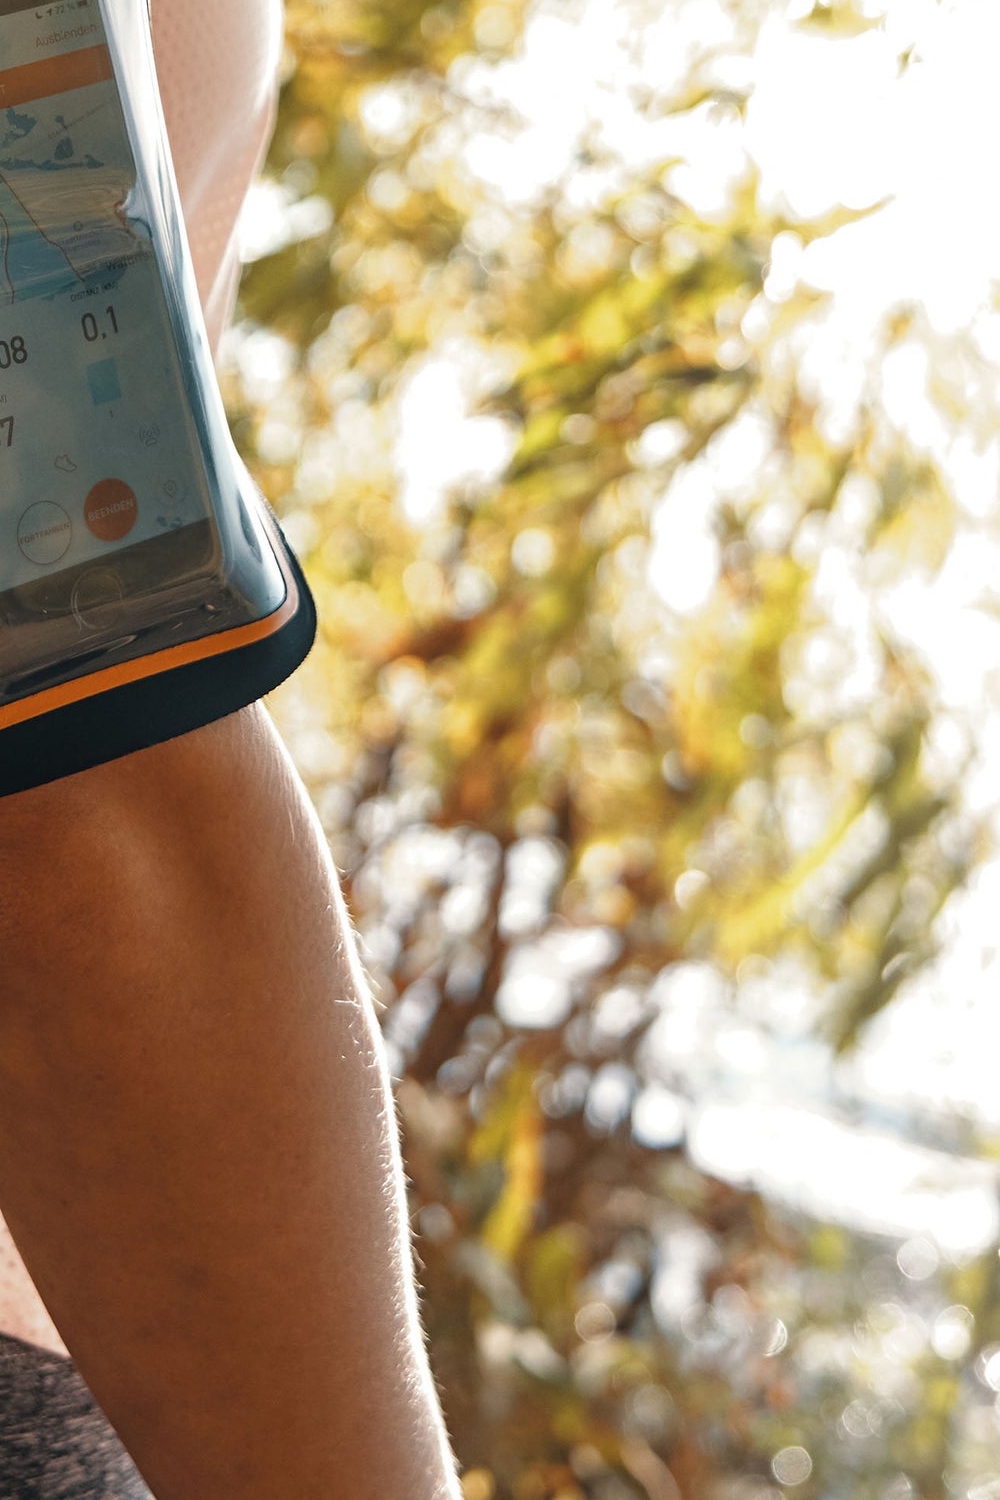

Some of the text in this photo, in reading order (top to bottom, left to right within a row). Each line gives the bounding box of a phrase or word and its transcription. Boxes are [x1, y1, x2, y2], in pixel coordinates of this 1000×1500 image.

[35, 23, 98, 48] Ausblenden
[80, 305, 120, 343] 0,1
[87, 497, 134, 522] BEENDEN
